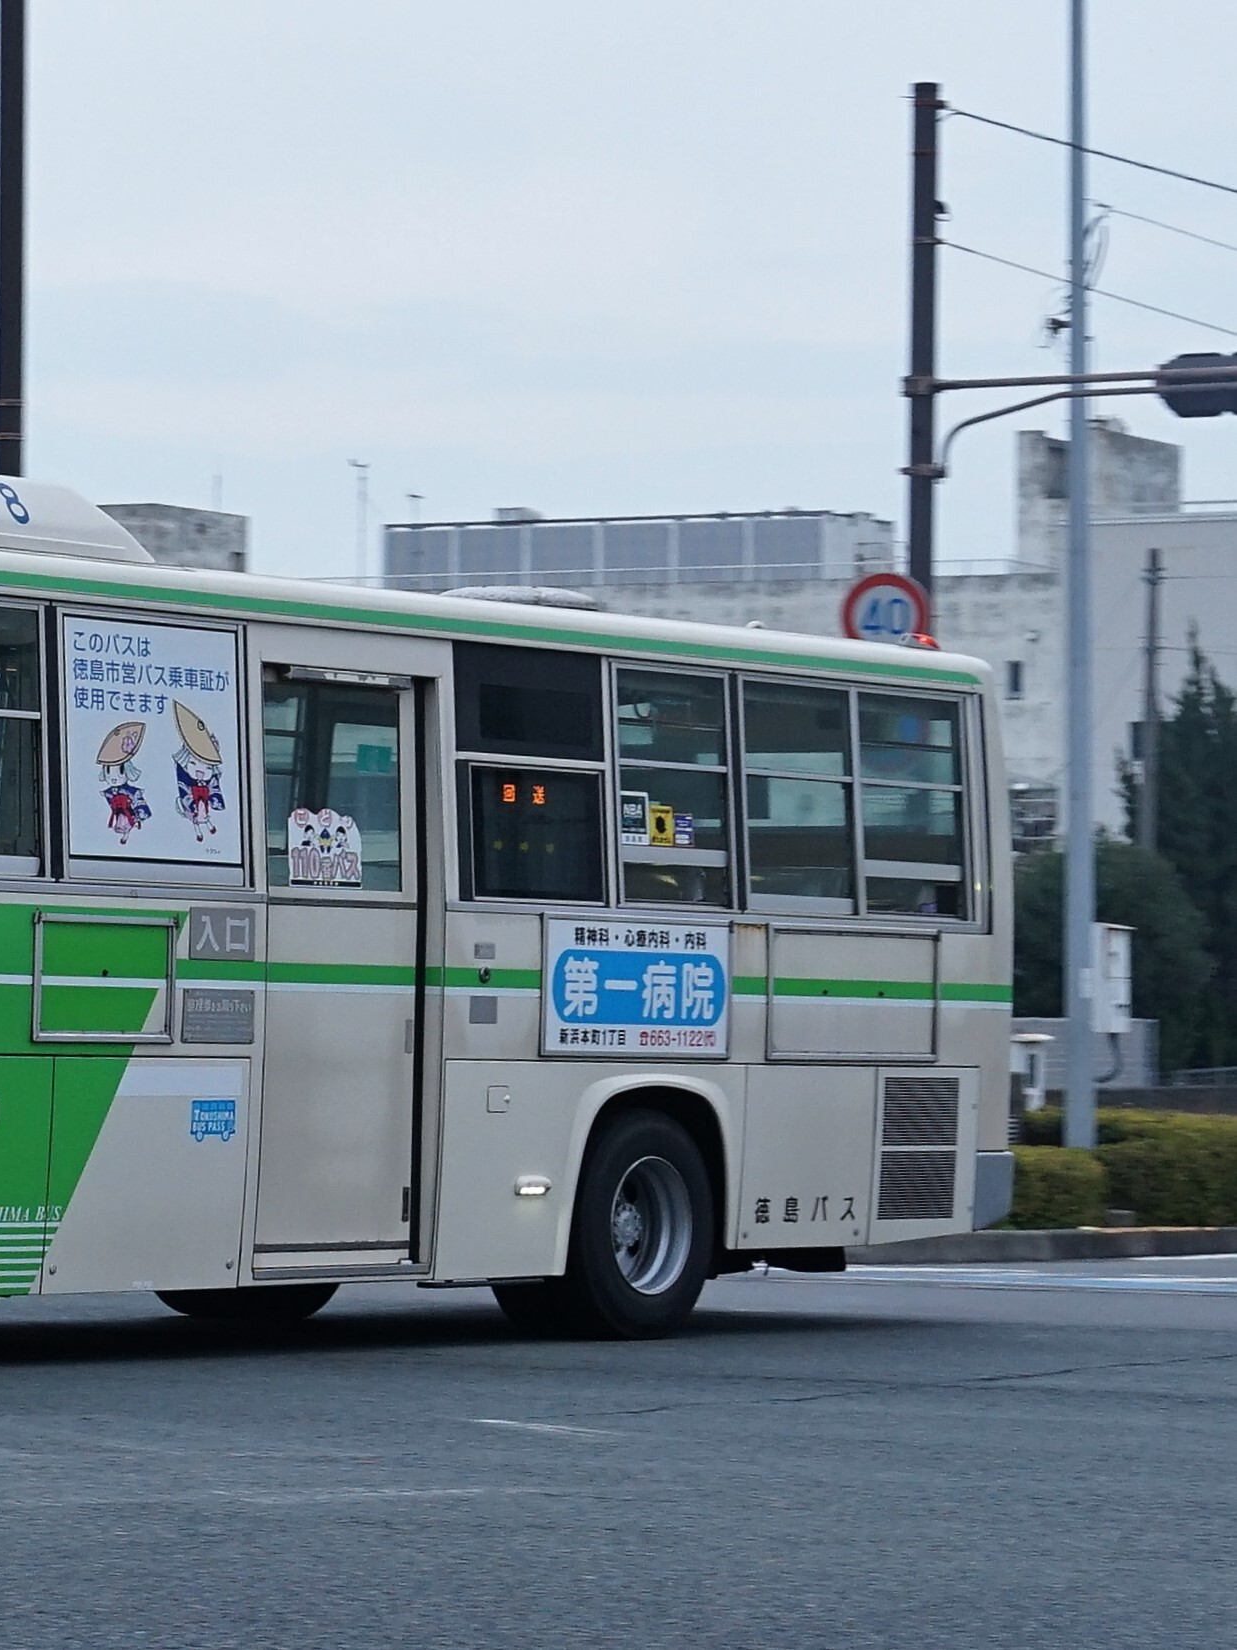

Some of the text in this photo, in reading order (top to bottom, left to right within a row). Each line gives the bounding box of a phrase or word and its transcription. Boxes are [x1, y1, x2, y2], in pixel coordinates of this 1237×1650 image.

[862, 598, 910, 635] 40
[73, 631, 151, 658] このバスは
[73, 658, 230, 692] 徳島市営バス乗車証が
[74, 685, 168, 715] 使用できます
[196, 915, 250, 953] 入口
[563, 956, 715, 1020] 第一病院
[35, 1205, 62, 1221] BUS
[755, 1196, 856, 1224] 徳島バス
